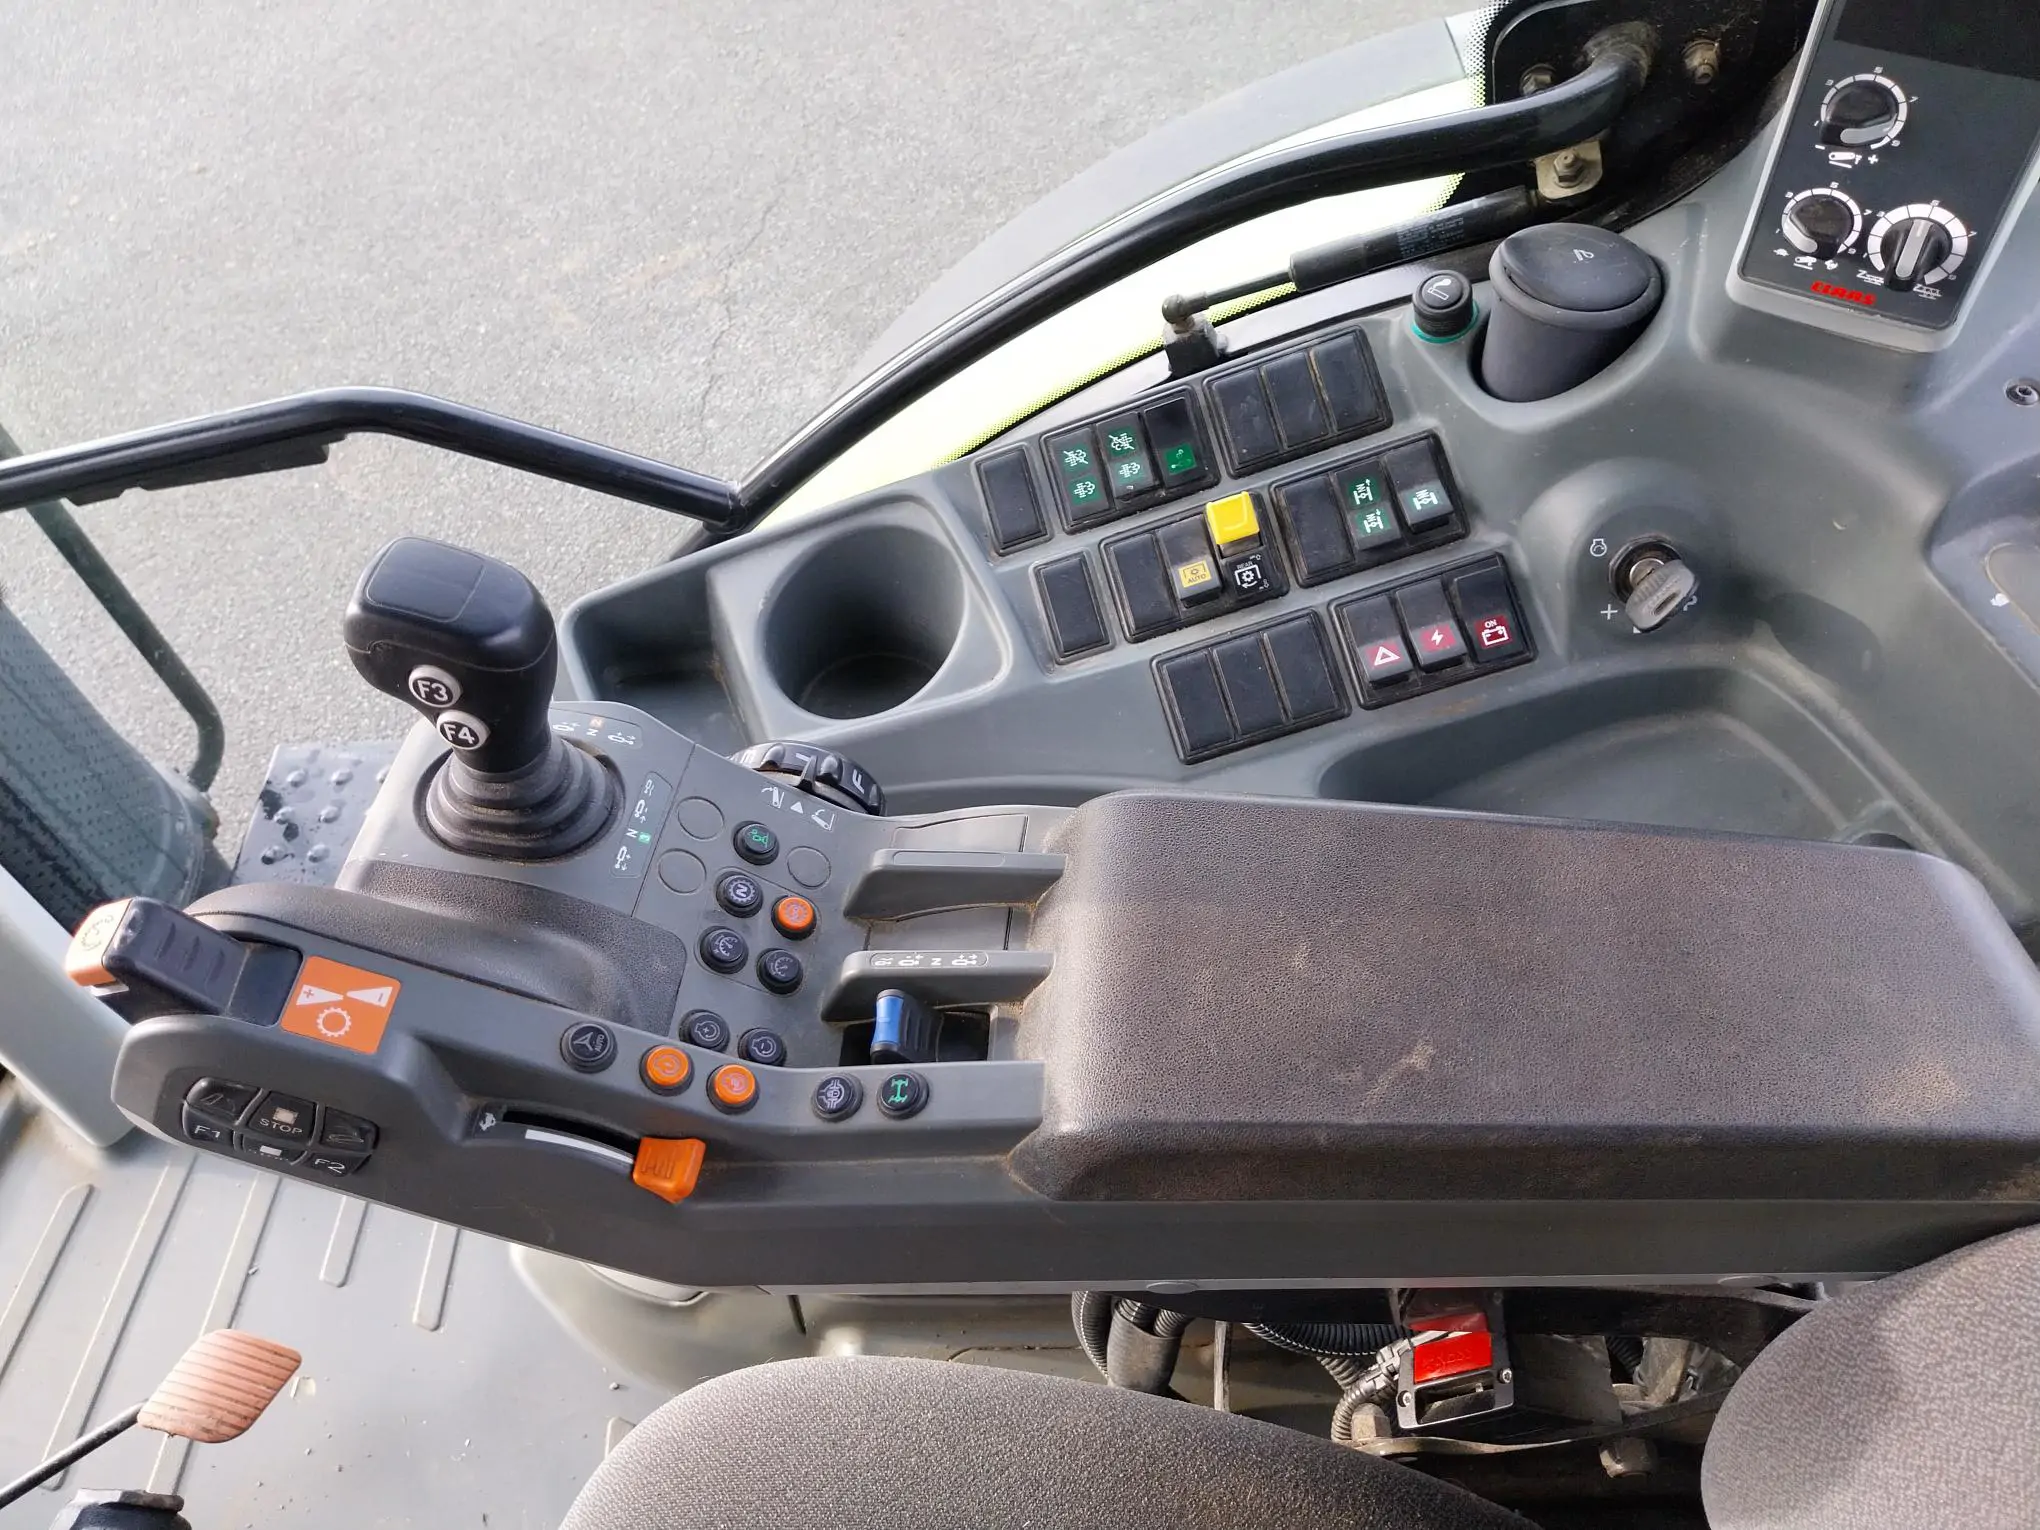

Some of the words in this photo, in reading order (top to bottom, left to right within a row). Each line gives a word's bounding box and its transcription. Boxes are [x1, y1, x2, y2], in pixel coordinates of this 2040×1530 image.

[1810, 281, 1876, 305] CLAAS
[1236, 561, 1253, 569] REAR
[1188, 573, 1206, 584] AUTO
[1484, 619, 1497, 628] ON
[417, 680, 448, 702] F3
[443, 723, 475, 744] F4
[586, 728, 599, 737] N
[626, 828, 639, 838] N
[931, 957, 942, 966] N
[194, 1124, 221, 1139] F1
[259, 1117, 303, 1134] STOP
[314, 1158, 346, 1174] F2
